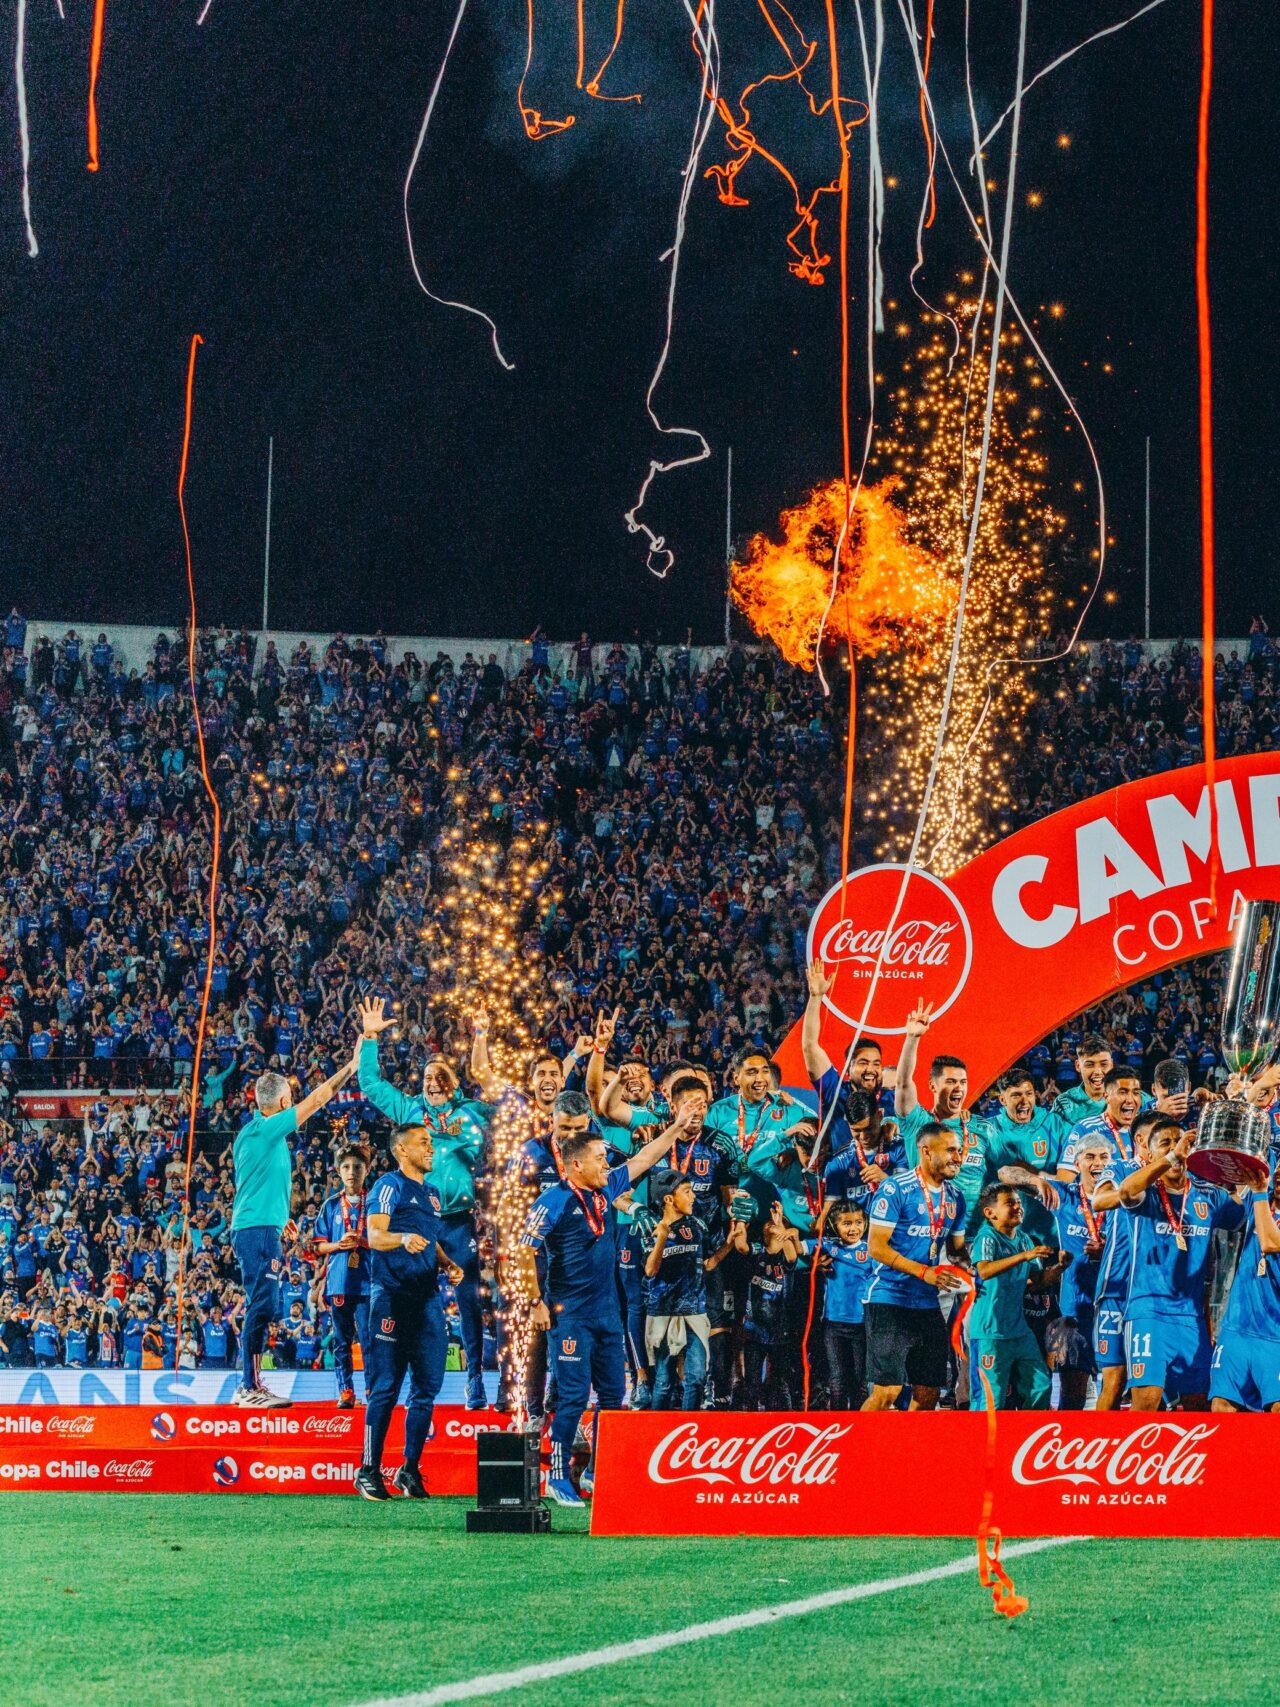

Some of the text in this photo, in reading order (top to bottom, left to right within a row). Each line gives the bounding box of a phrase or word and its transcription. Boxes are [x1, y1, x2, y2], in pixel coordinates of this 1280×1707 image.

[1113, 888, 1248, 966] COPA
[820, 919, 959, 966] CocaCola
[853, 969, 924, 979] SIN AZÚCAR
[33, 1103, 55, 1111] SALIDA
[693, 1183, 713, 1191] BET
[1132, 1332, 1152, 1358] 11
[46, 1415, 97, 1434] Coca-Cola
[185, 1415, 299, 1437] Copa Chile
[303, 1415, 354, 1434] Coca-Cola
[648, 1422, 854, 1485] Coca-Cola
[1012, 1423, 1220, 1486] Coca-Cola
[46, 1460, 100, 1478] Chile
[103, 1459, 156, 1478] Coca-Cola
[250, 1461, 306, 1482] Copa
[696, 1490, 800, 1504] SIN AZÚCAR
[1061, 1491, 1167, 1505] SIN AZÚCAR
